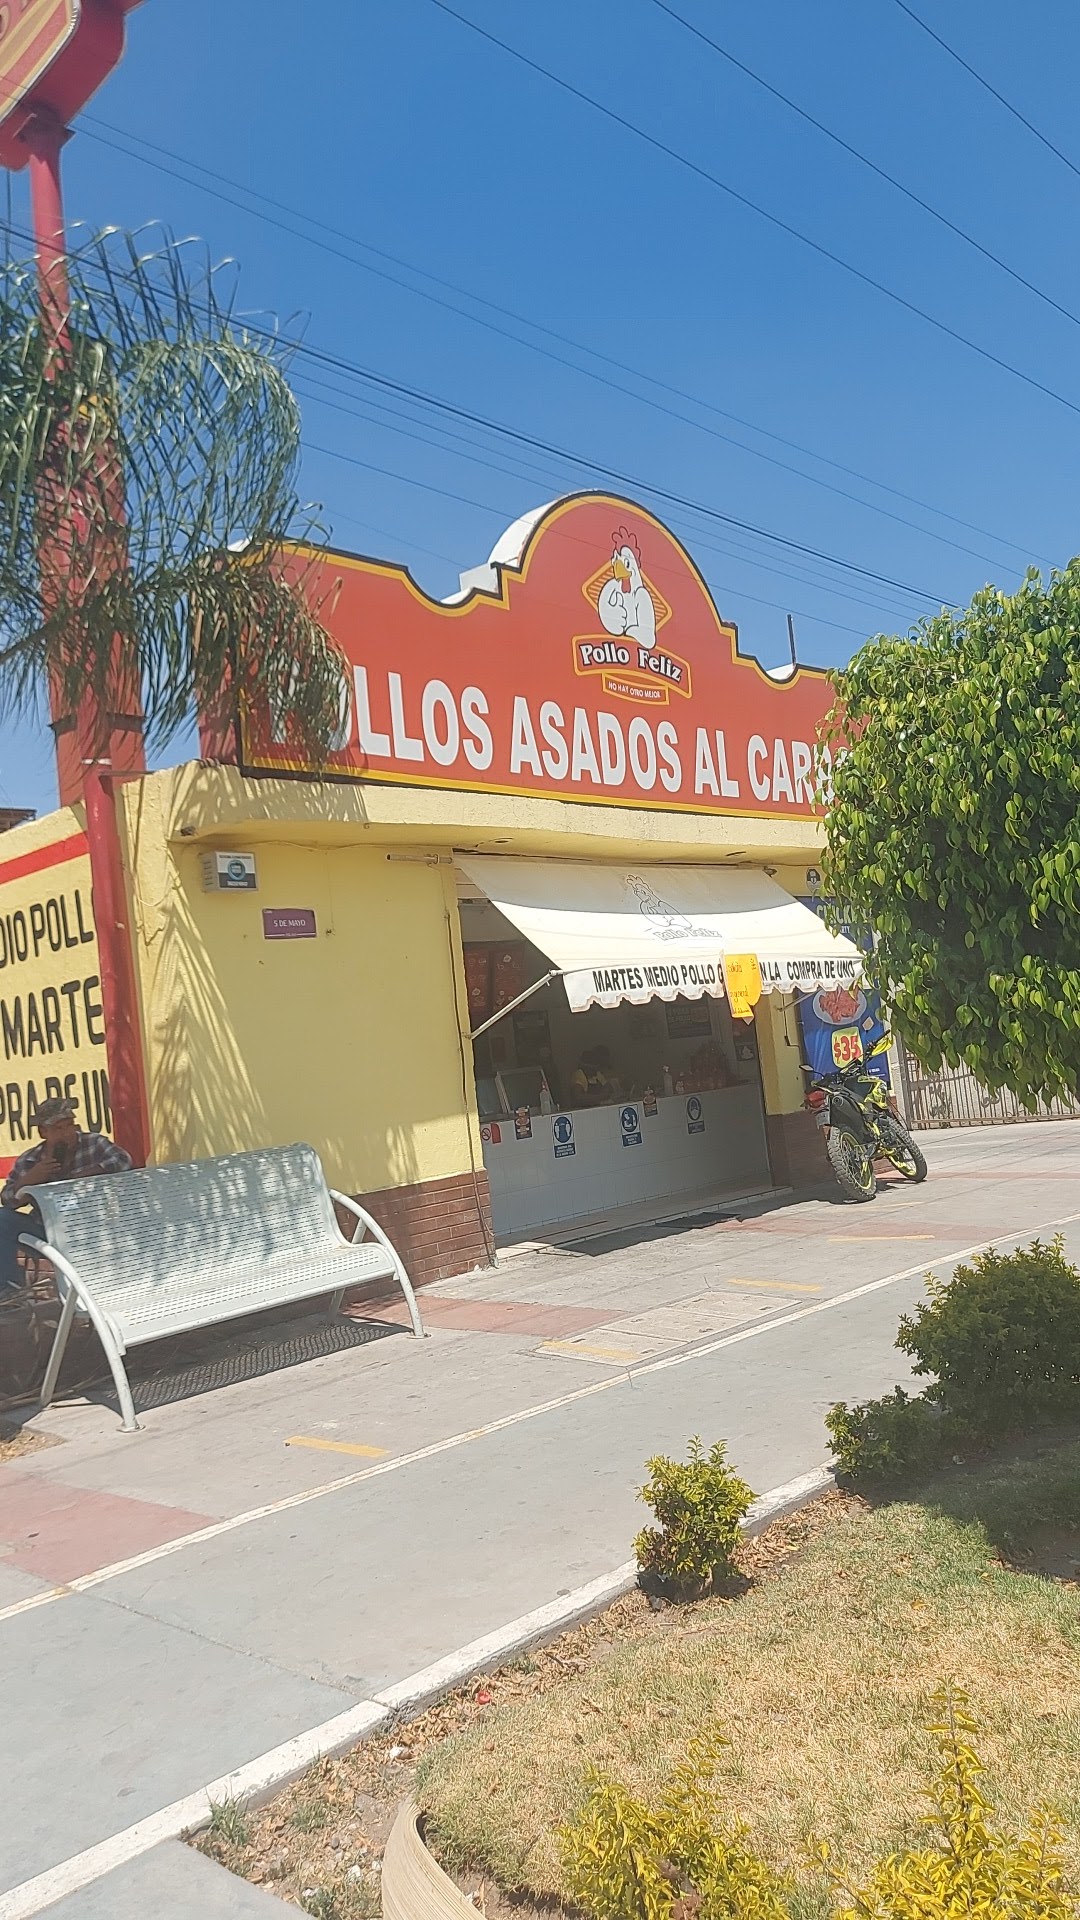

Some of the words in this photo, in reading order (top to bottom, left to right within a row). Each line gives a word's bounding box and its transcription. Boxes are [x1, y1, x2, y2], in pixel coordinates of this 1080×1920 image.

[579, 642, 630, 666] Pollo
[638, 648, 684, 682] Feliz
[608, 682, 618, 692] NO
[618, 684, 629, 694] HAY
[629, 688, 643, 697] OTRO
[644, 690, 661, 699] MEJOR
[510, 695, 682, 793] ASADOS
[694, 727, 740, 798] AL
[273, 920, 279, 928] 5
[288, 919, 306, 927] MAYO
[592, 967, 644, 993] MARTES
[643, 965, 679, 987] MEDIO
[680, 963, 716, 986] POLLO
[768, 961, 782, 981] LA
[786, 960, 824, 981] COMPRA
[824, 960, 836, 979] DE
[836, 959, 856, 979] UNO
[833, 1034, 862, 1064] $35
